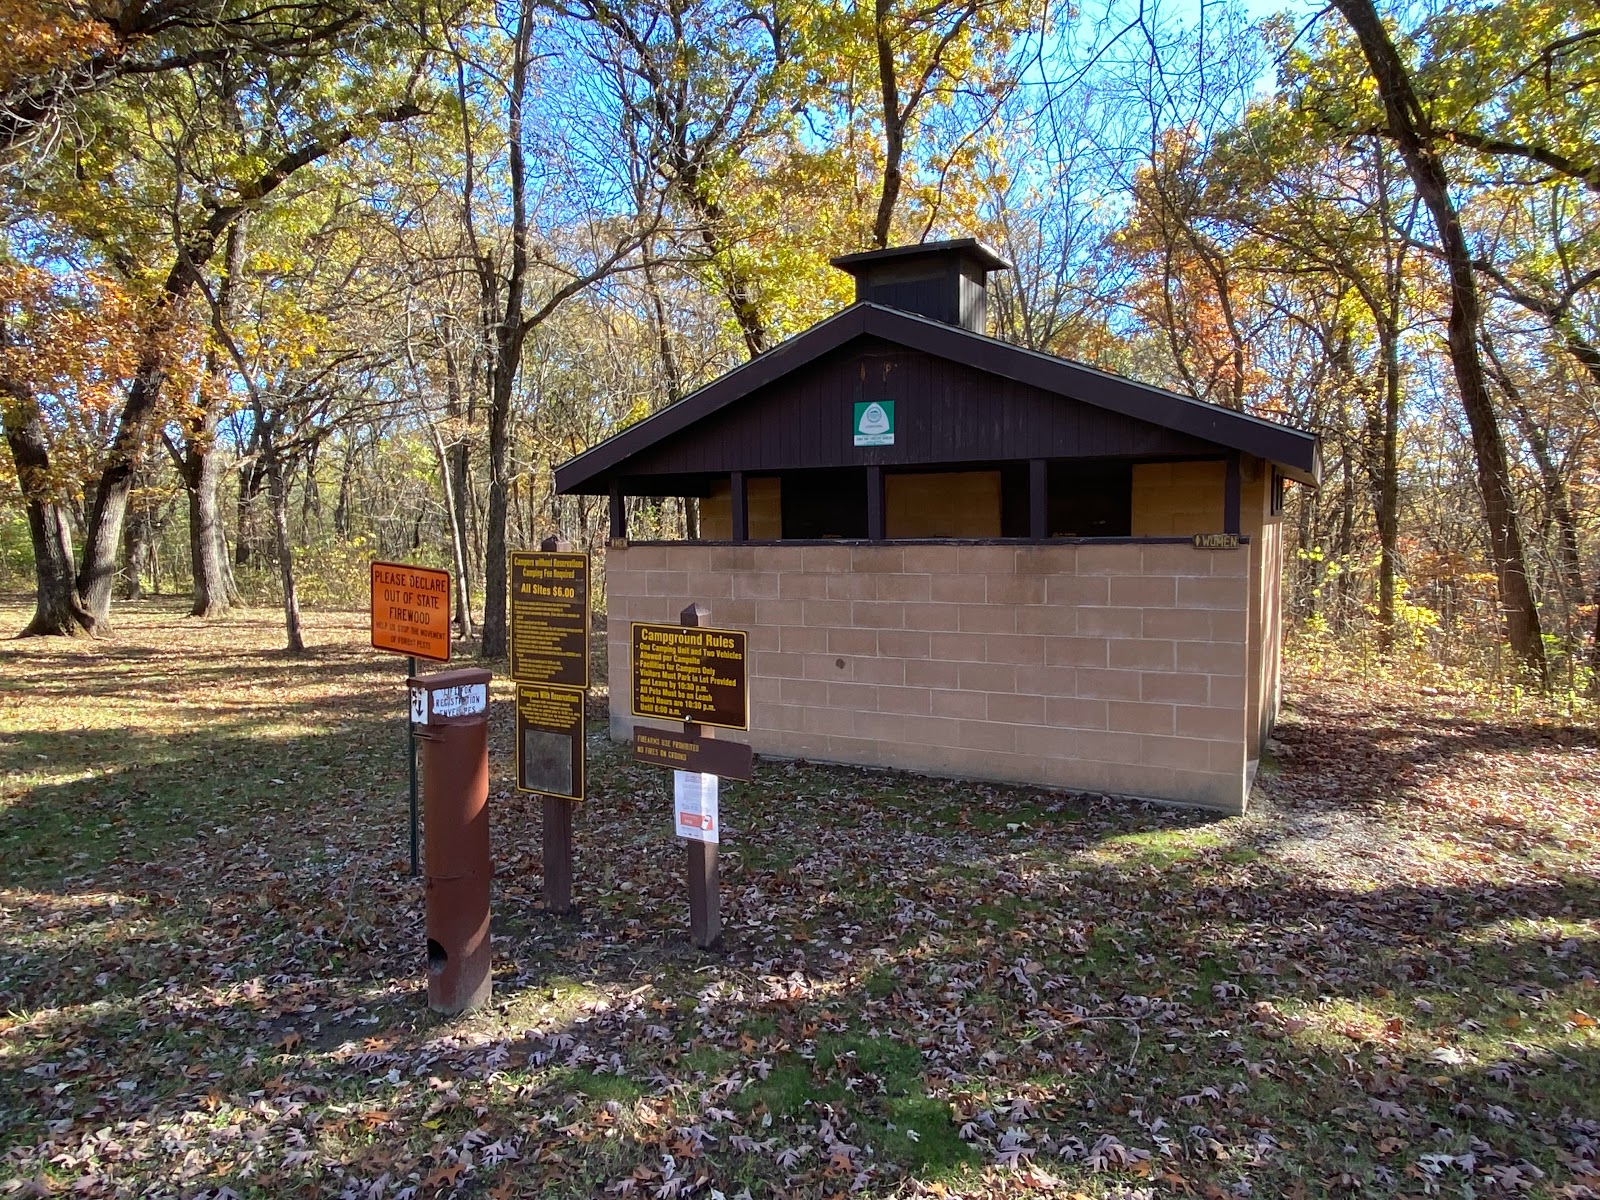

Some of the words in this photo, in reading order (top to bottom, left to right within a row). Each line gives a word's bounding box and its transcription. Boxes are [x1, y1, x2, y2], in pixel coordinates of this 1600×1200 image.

[1202, 534, 1237, 546] WOMEN
[514, 557, 534, 567] Campers
[535, 558, 552, 566] without
[554, 558, 584, 568] Reservations
[374, 570, 406, 586] PLEASE
[410, 575, 446, 592] DECLARE
[523, 568, 543, 578] Camping
[544, 569, 552, 577] Fee
[554, 569, 574, 579] Required
[521, 583, 531, 593] All
[533, 584, 550, 595] Sites
[553, 586, 574, 598] $6.00
[384, 589, 400, 602] OUT
[403, 592, 413, 604] OF
[417, 594, 439, 609] STATE
[390, 607, 430, 624] FIREWOOD
[376, 622, 388, 630] HELP
[420, 629, 446, 640] MOVEMENT
[642, 628, 702, 646] Campground
[706, 634, 734, 648] Rules
[398, 637, 416, 646] FOREST
[416, 641, 430, 650] PESTS
[640, 652, 662, 660] Allowed
[663, 654, 672, 662] per
[674, 655, 700, 665] Campsite
[652, 644, 676, 654] Camping
[678, 646, 690, 654] Unit
[703, 648, 714, 657] Two
[716, 650, 742, 660] Vehicles
[640, 660, 665, 670] Facilities
[676, 664, 700, 674] Campers
[702, 667, 716, 676] Only
[640, 668, 660, 678] Visitors
[662, 671, 676, 680] Must
[678, 673, 691, 682] Park
[692, 674, 698, 682] in
[700, 676, 709, 684] Lot
[710, 677, 737, 686] Provided
[669, 681, 676, 690] by
[678, 682, 694, 690] 10:30
[521, 688, 539, 699] Campers
[551, 692, 578, 702] Reservations
[649, 687, 660, 696] Pets
[662, 688, 676, 698] Must
[678, 690, 686, 698] be
[696, 692, 712, 702] Leash
[640, 694, 654, 704] Quiet
[656, 696, 672, 706] Hours
[685, 700, 702, 710] 10:30
[703, 704, 716, 712] p.m.
[640, 702, 654, 712] Until
[638, 734, 660, 745] FIREARMS
[661, 739, 671, 747] USE
[672, 740, 700, 752] PROHIBITED
[645, 746, 658, 756] FIRES
[668, 752, 686, 761] GROUND
